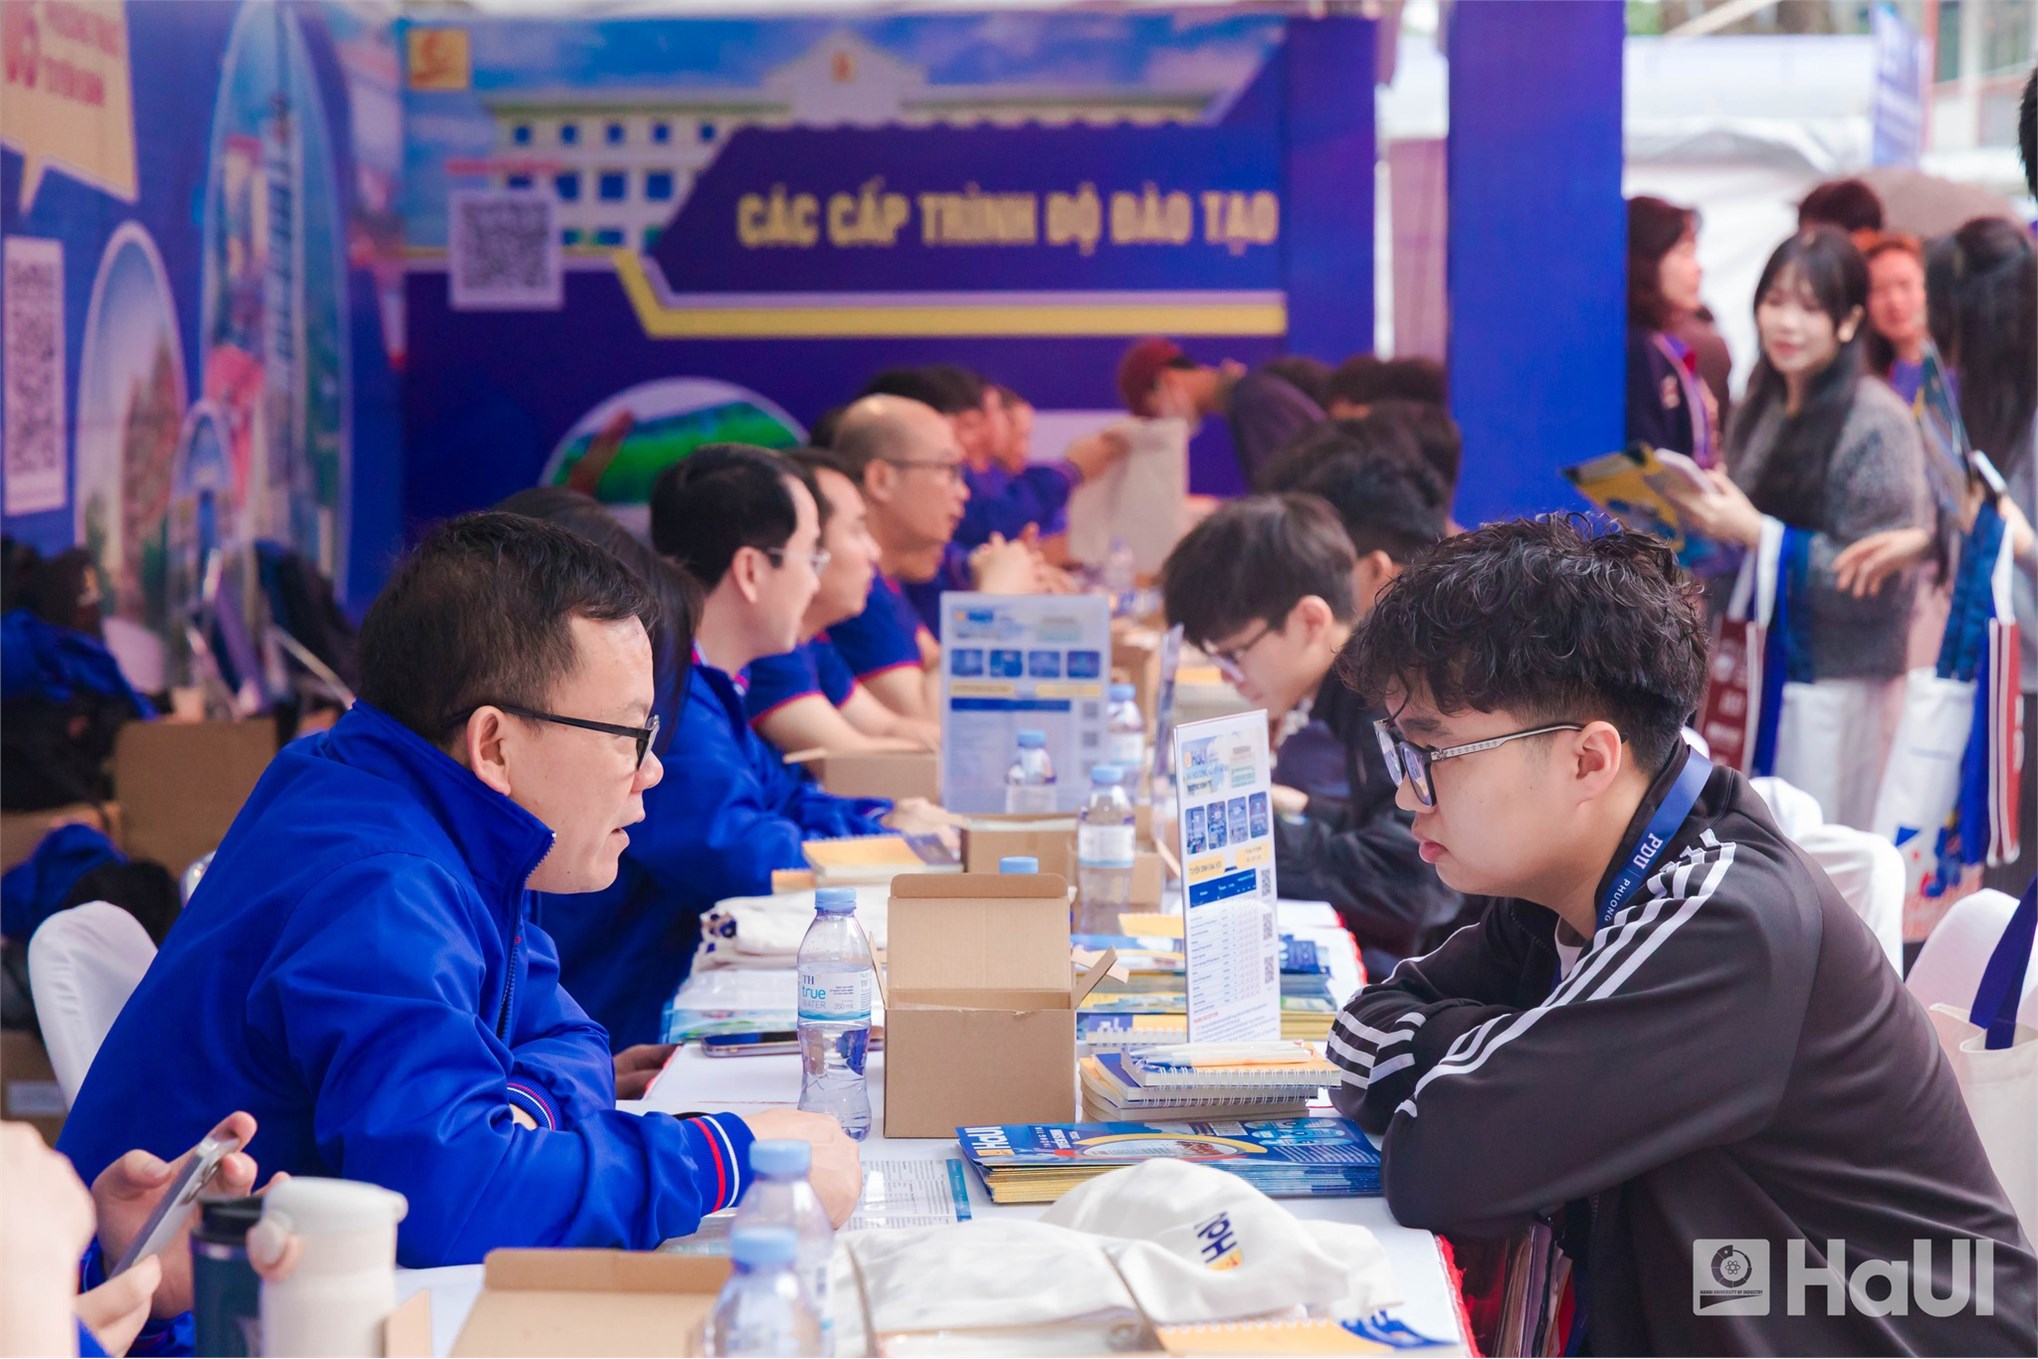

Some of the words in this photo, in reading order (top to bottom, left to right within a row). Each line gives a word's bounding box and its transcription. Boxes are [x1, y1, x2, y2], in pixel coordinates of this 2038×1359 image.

[737, 182, 818, 247] CÁC
[827, 176, 909, 247] CẤP
[918, 180, 1037, 246] TRÌNH
[1045, 182, 1101, 256] ĐỘ
[1110, 180, 1193, 245] ĐÀO
[1202, 190, 1279, 256] TẠO
[1633, 833, 1663, 870] PDU
[1604, 879, 1631, 922] PHUONG
[802, 985, 826, 1000] true
[802, 999, 826, 1009] WATER
